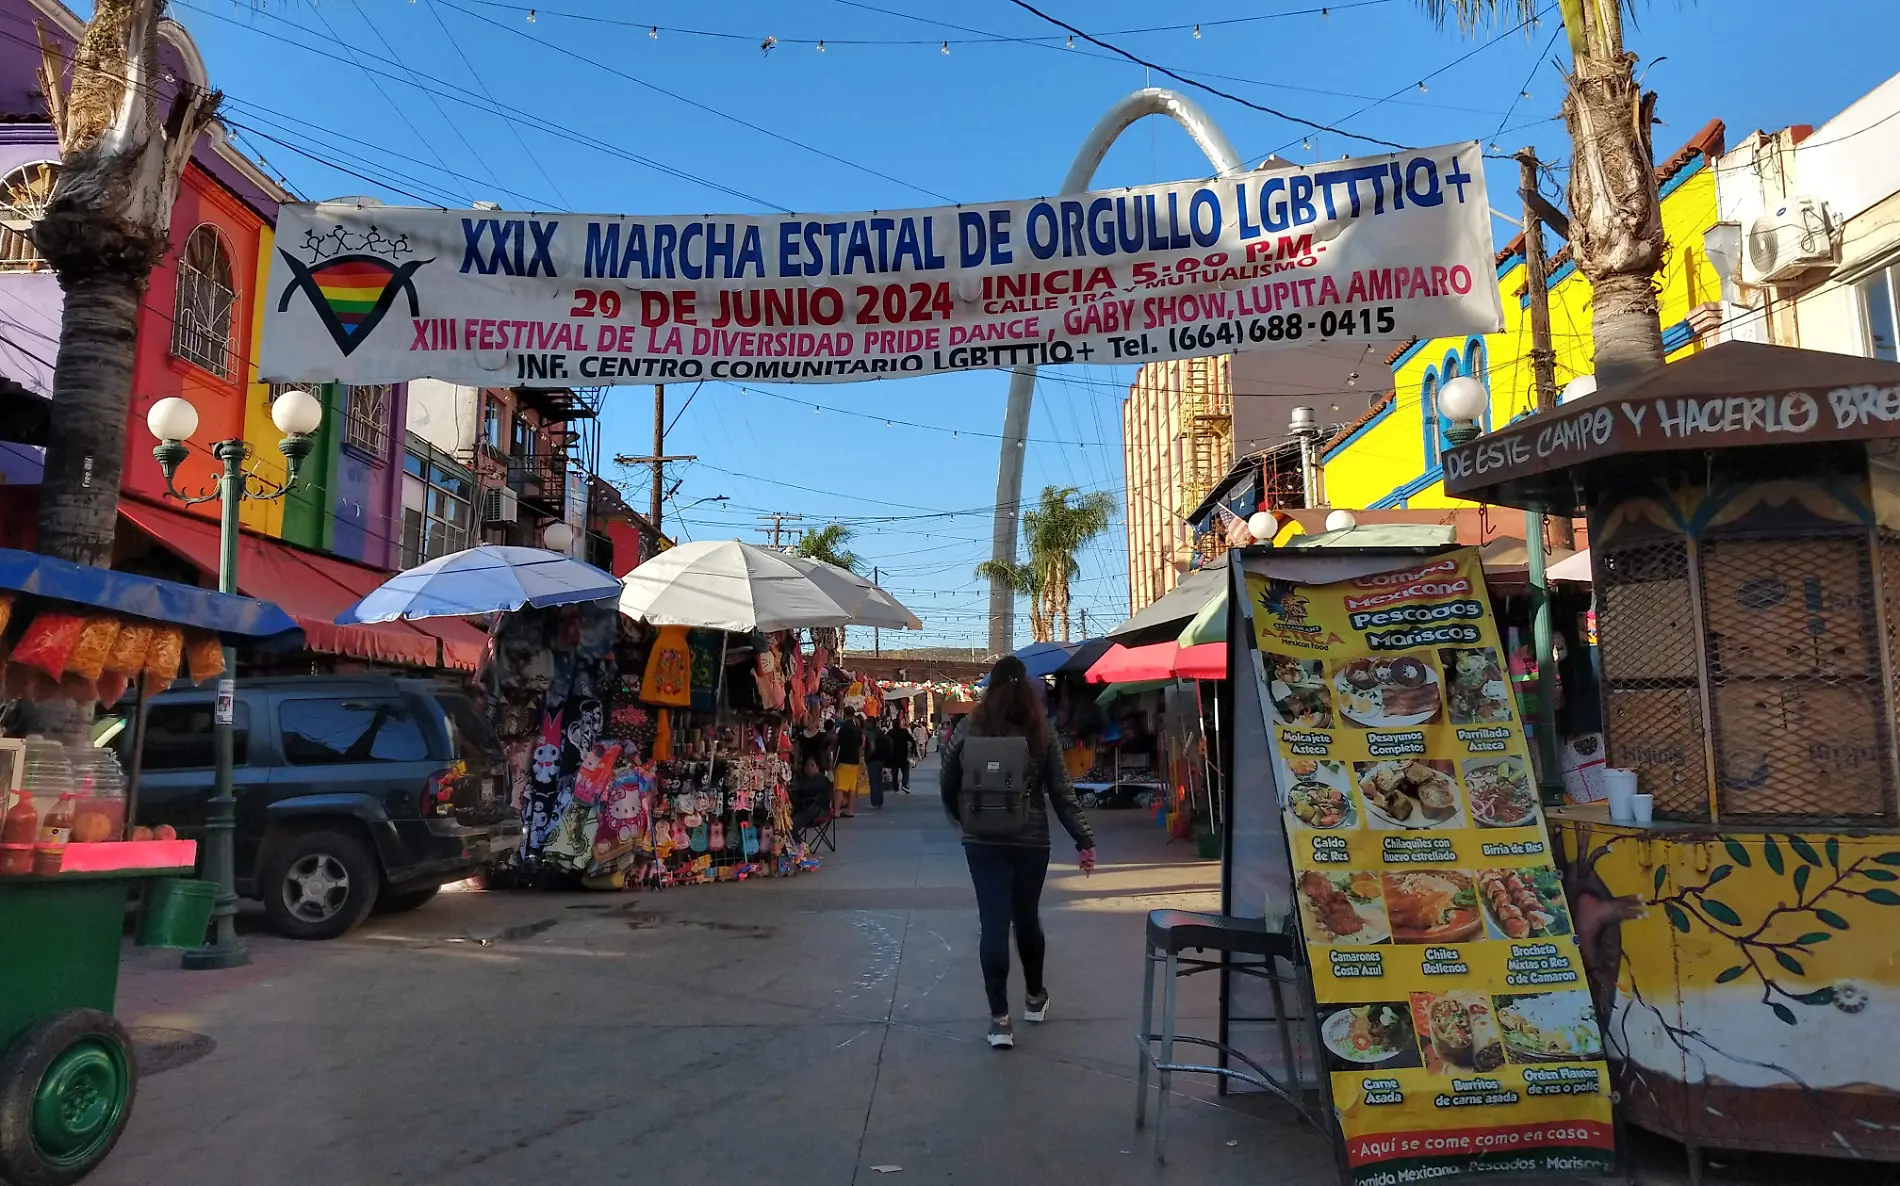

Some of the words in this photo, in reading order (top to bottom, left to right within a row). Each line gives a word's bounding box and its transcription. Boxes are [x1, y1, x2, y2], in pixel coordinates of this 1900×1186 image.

[459, 218, 559, 278] XXIX
[584, 221, 766, 280] MARCHA
[779, 216, 945, 277] ESTATAL
[958, 209, 1013, 269] DE
[1026, 188, 1222, 260] ORGULLO
[1236, 155, 1472, 241] LGBTTTIQ+
[983, 297, 1059, 315] CALLE
[1068, 290, 1115, 307] 1RA
[1145, 256, 1318, 290] MUTUALISMO
[569, 289, 621, 319] 29
[640, 290, 698, 328] DE
[711, 287, 844, 328] JUNIO
[855, 281, 954, 325] 2024
[982, 266, 1118, 300] INICIA
[409, 318, 457, 352] XIII
[464, 319, 588, 352] FESTIVAL
[597, 325, 635, 354] DE
[646, 326, 684, 357] LA
[691, 330, 854, 357] DIVERSIDAD
[863, 328, 940, 354] PRIDE
[1063, 298, 1135, 336] GABY
[1239, 276, 1337, 316] LUPITA
[1345, 264, 1472, 303] AMPARO
[516, 353, 569, 380] INF.
[579, 355, 703, 379] CENTRO
[710, 354, 923, 379] COMUNITARIO
[933, 340, 1095, 369] LGBTTTIQ+
[1107, 333, 1158, 359] Tel.
[1447, 450, 1473, 480] DE
[1475, 435, 1531, 475] ESTE
[1536, 406, 1614, 457] CAMPO
[1621, 402, 1647, 437] Y
[1655, 390, 1819, 438] HACERLO
[1348, 578, 1469, 610] Mexicana
[1369, 627, 1478, 648] Mariscos
[1282, 732, 1331, 745] Molcajete
[1367, 731, 1423, 744] Desayunos
[1457, 727, 1511, 741] Parrillada
[1292, 744, 1327, 755] Azteca
[1369, 743, 1424, 756] Completos
[1468, 740, 1504, 752] Azteca
[1312, 837, 1346, 849] Caldo
[1384, 838, 1432, 850] Chilaquiles
[1433, 839, 1450, 848] con
[1482, 843, 1510, 856] Birria
[1511, 843, 1524, 854] de
[1525, 841, 1543, 853] Res
[1314, 850, 1328, 861] de
[1330, 851, 1349, 862] Res
[1384, 851, 1410, 862] huevo
[1411, 851, 1456, 861] estrellado
[1330, 950, 1381, 962] Camarones
[1425, 948, 1458, 961] Chiles
[1512, 945, 1556, 957] Brocheta
[1423, 962, 1467, 975] Rellenos
[1508, 959, 1540, 970] Mixtas
[1549, 957, 1569, 968] Res
[1333, 964, 1360, 977] Costa
[1361, 964, 1383, 976] Azul
[1507, 976, 1515, 984] o
[1516, 974, 1529, 984] de
[1530, 971, 1576, 983] Camaron
[1524, 1069, 1559, 1081] Orden
[1363, 1078, 1398, 1090] Carne
[1453, 1079, 1498, 1092] Burritos
[1528, 1083, 1542, 1094] de
[1545, 1084, 1560, 1093] res
[1563, 1084, 1570, 1092] o
[1365, 1091, 1402, 1104] Asada
[1435, 1095, 1450, 1106] de
[1453, 1095, 1484, 1105] carne
[1485, 1092, 1517, 1103] asada
[1360, 1138, 1396, 1158] Aquí
[1401, 1140, 1420, 1151] se
[1425, 1135, 1470, 1149] come
[1475, 1131, 1519, 1147] como
[1524, 1129, 1542, 1141] en
[1547, 1127, 1588, 1140] casa
[1398, 1164, 1460, 1182] Mexicana
